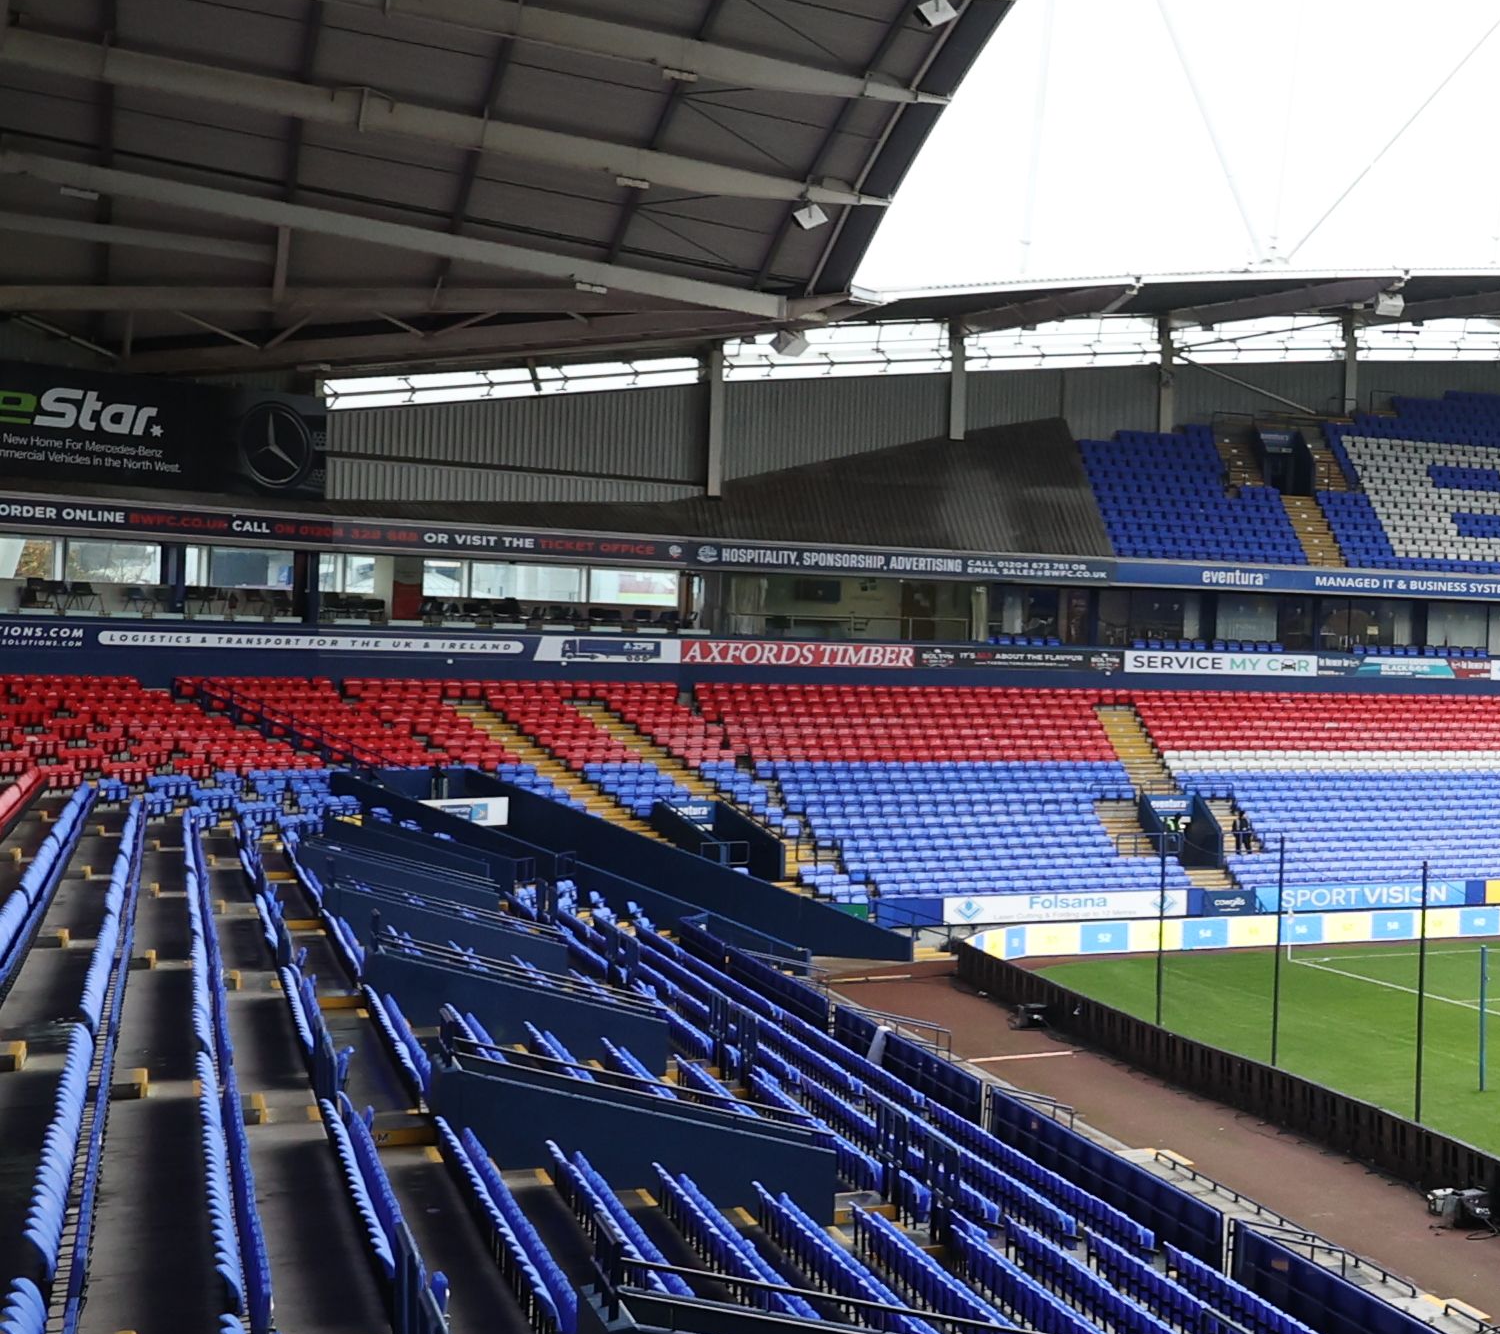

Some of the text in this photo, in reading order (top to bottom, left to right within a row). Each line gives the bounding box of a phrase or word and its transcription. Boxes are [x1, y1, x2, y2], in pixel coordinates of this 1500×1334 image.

[3, 432, 163, 458] New Home For Mercedes-Benz
[48, 451, 152, 471] Vehicles in the North
[0, 504, 656, 556] ORDER ONLINE CALL OR VISIT THE TICKET OFFICE
[722, 548, 962, 572] HOSPITALITY, SPONSORSHIP, ADVERTISING
[967, 559, 995, 567] CALL
[967, 566, 999, 575] EMAIL
[1202, 569, 1264, 586] eventura
[1315, 576, 1380, 589] MANAGED
[1382, 578, 1395, 589] IT
[1397, 580, 1407, 590] &
[1409, 581, 1467, 593] BUSINESS
[110, 633, 511, 651] LOGISTICS TRANSPORT FOR THE UK IRELAND
[682, 643, 914, 667] AXFORDS TIMBER
[1133, 655, 1222, 670] SERVICE
[1230, 658, 1260, 672] MY
[1029, 894, 1108, 909] Folsana
[1281, 888, 1361, 907] SPORT
